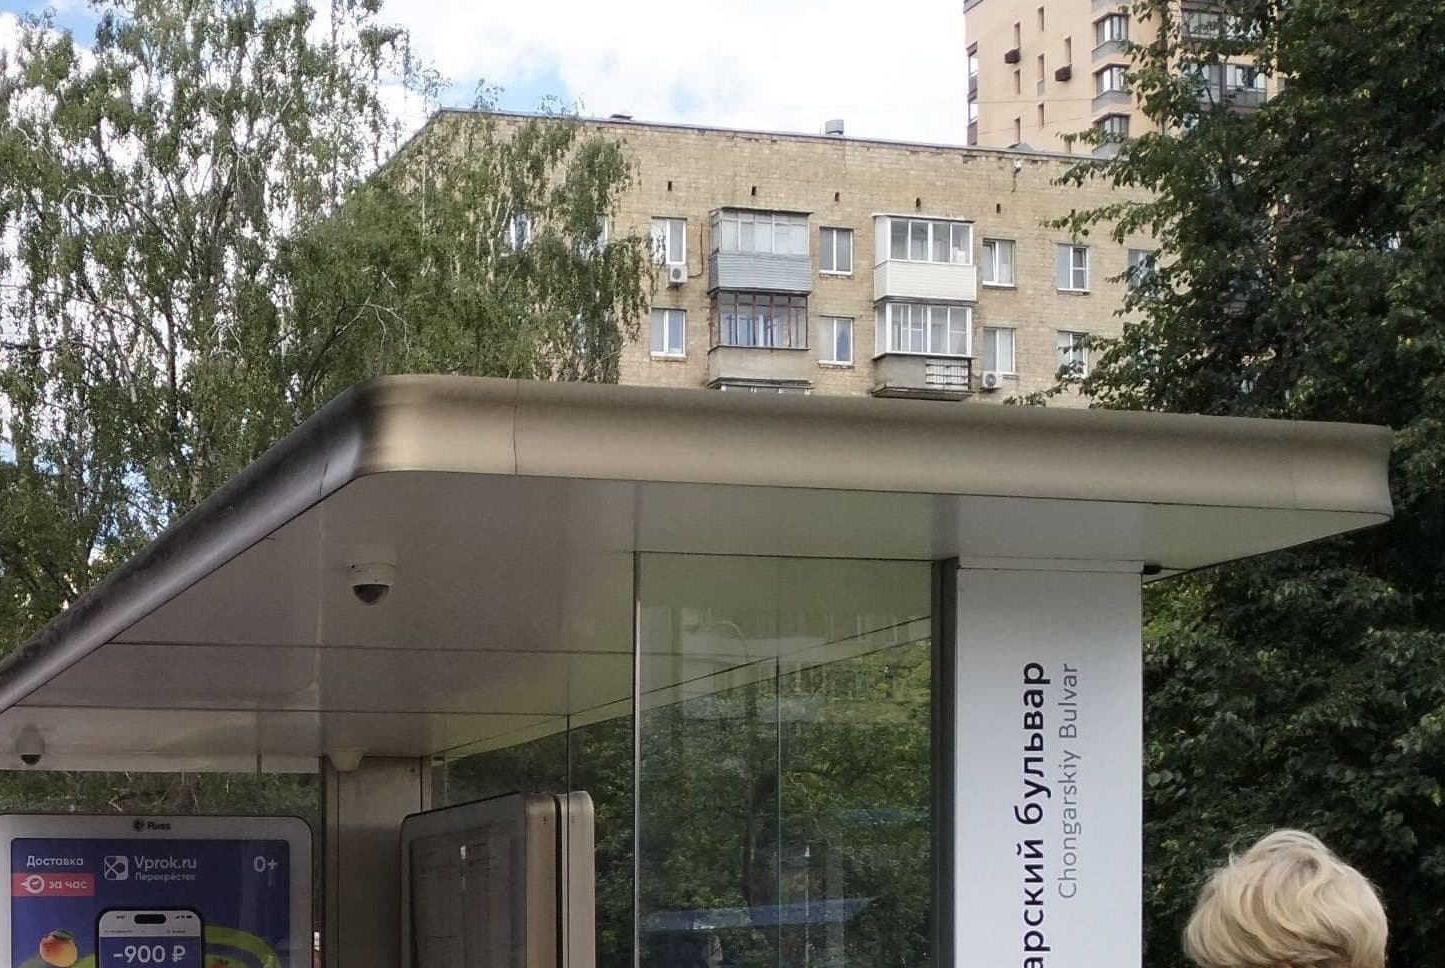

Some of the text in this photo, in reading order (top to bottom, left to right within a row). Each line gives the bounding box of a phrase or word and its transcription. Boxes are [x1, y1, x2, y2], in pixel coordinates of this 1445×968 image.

[1014, 661, 1051, 826] бульвар
[1058, 663, 1082, 899] Chongarskiy Bulvar
[26, 855, 84, 868] Доставка
[134, 855, 197, 872] Vprok.ru
[253, 855, 278, 872] 0+
[49, 880, 88, 889] за час
[113, 945, 186, 963] -900 ₽
